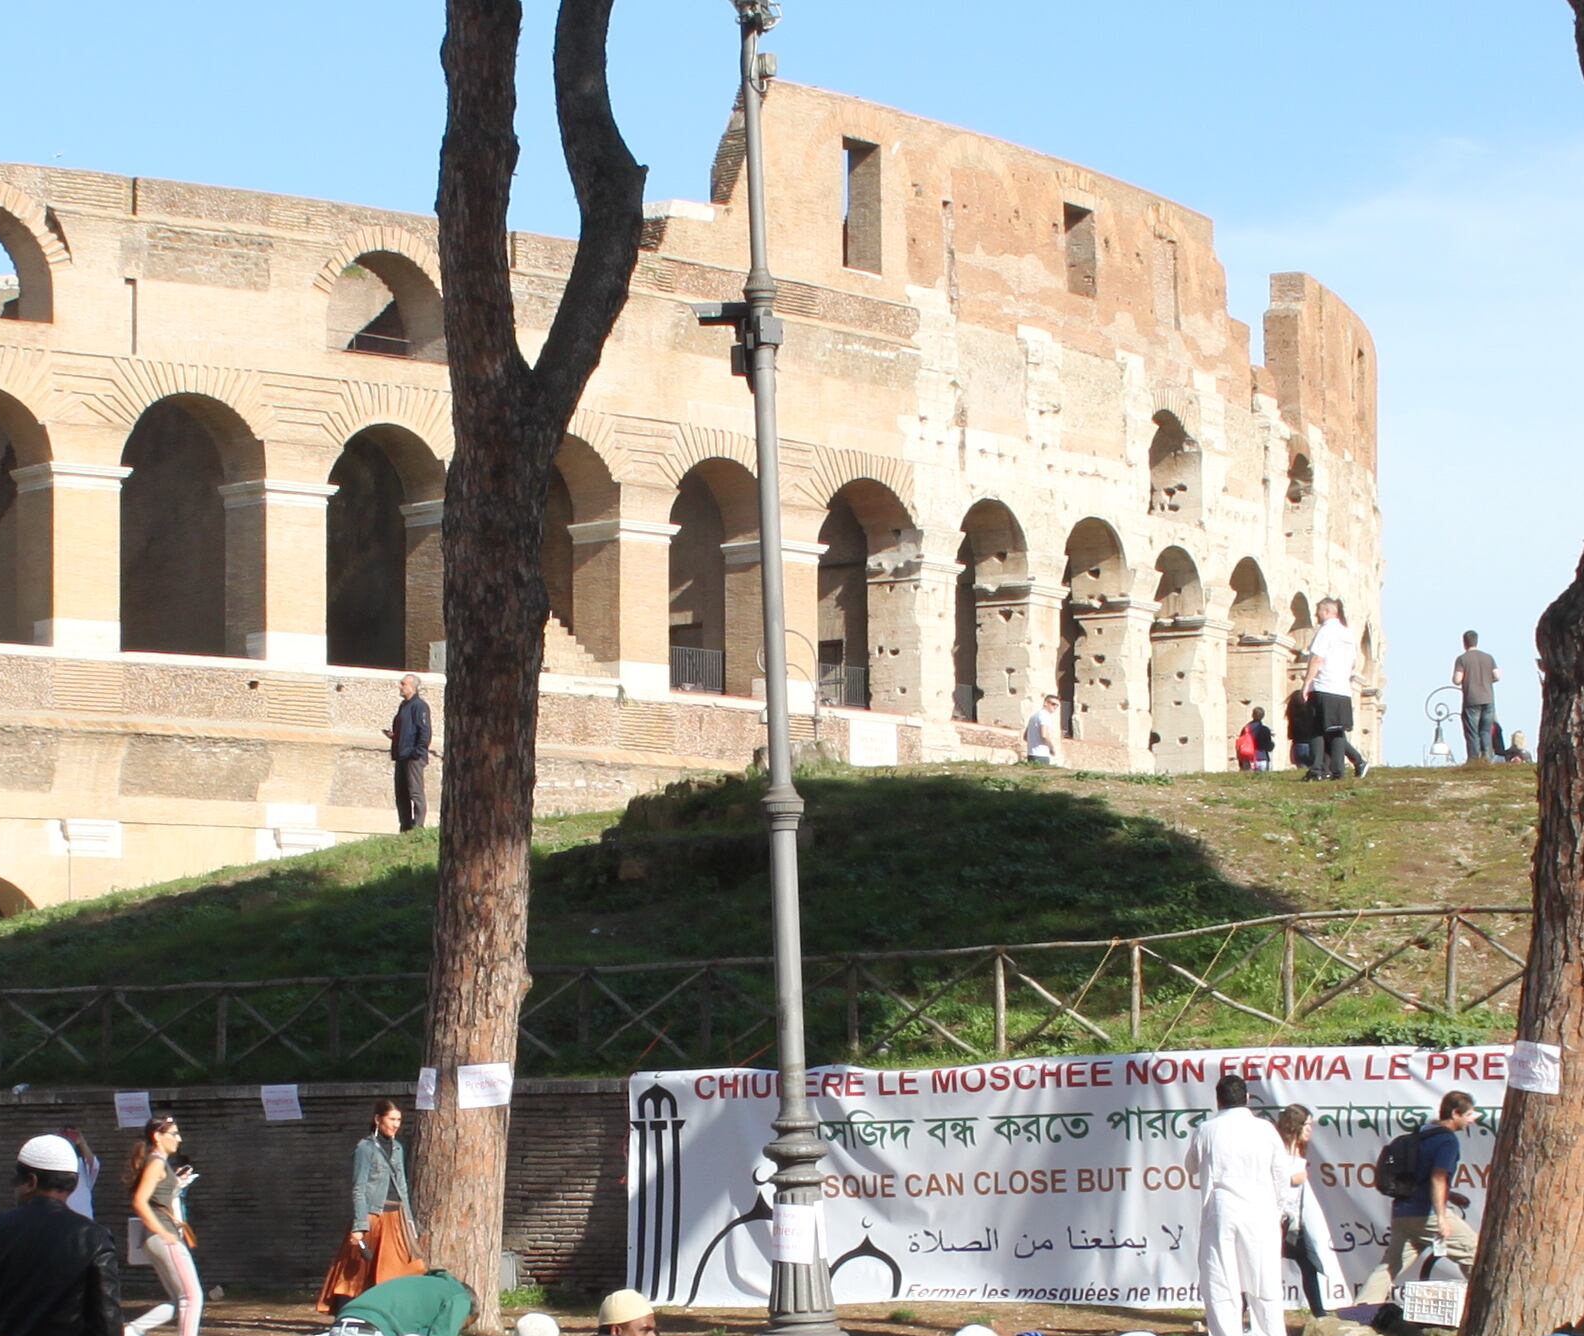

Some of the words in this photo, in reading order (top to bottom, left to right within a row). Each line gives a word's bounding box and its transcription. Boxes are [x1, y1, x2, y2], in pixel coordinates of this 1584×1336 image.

[694, 1071, 866, 1100] CHIUERE
[878, 1070, 919, 1096] LE
[931, 1061, 1113, 1094] MOSCHEE
[1126, 1057, 1205, 1085] NON
[1219, 1052, 1352, 1081] FERMA
[1364, 1053, 1412, 1080] LE
[818, 1109, 914, 1150] সজিদ
[923, 1116, 979, 1149] বন্ধ
[988, 1112, 1094, 1145] করতে
[823, 1173, 897, 1199] SQUE
[905, 1171, 964, 1198] CAN
[973, 1168, 1067, 1195] CLOSE
[1077, 1167, 1132, 1193] BUT
[1320, 1163, 1379, 1188] STO
[1015, 1233, 1054, 1259] من
[905, 1283, 976, 1300] Fermer
[982, 1283, 1010, 1300] les
[1016, 1281, 1119, 1302] mosquées
[1126, 1286, 1150, 1301] ne
[1157, 1283, 1201, 1301] mett
[1326, 1279, 1345, 1300] la
